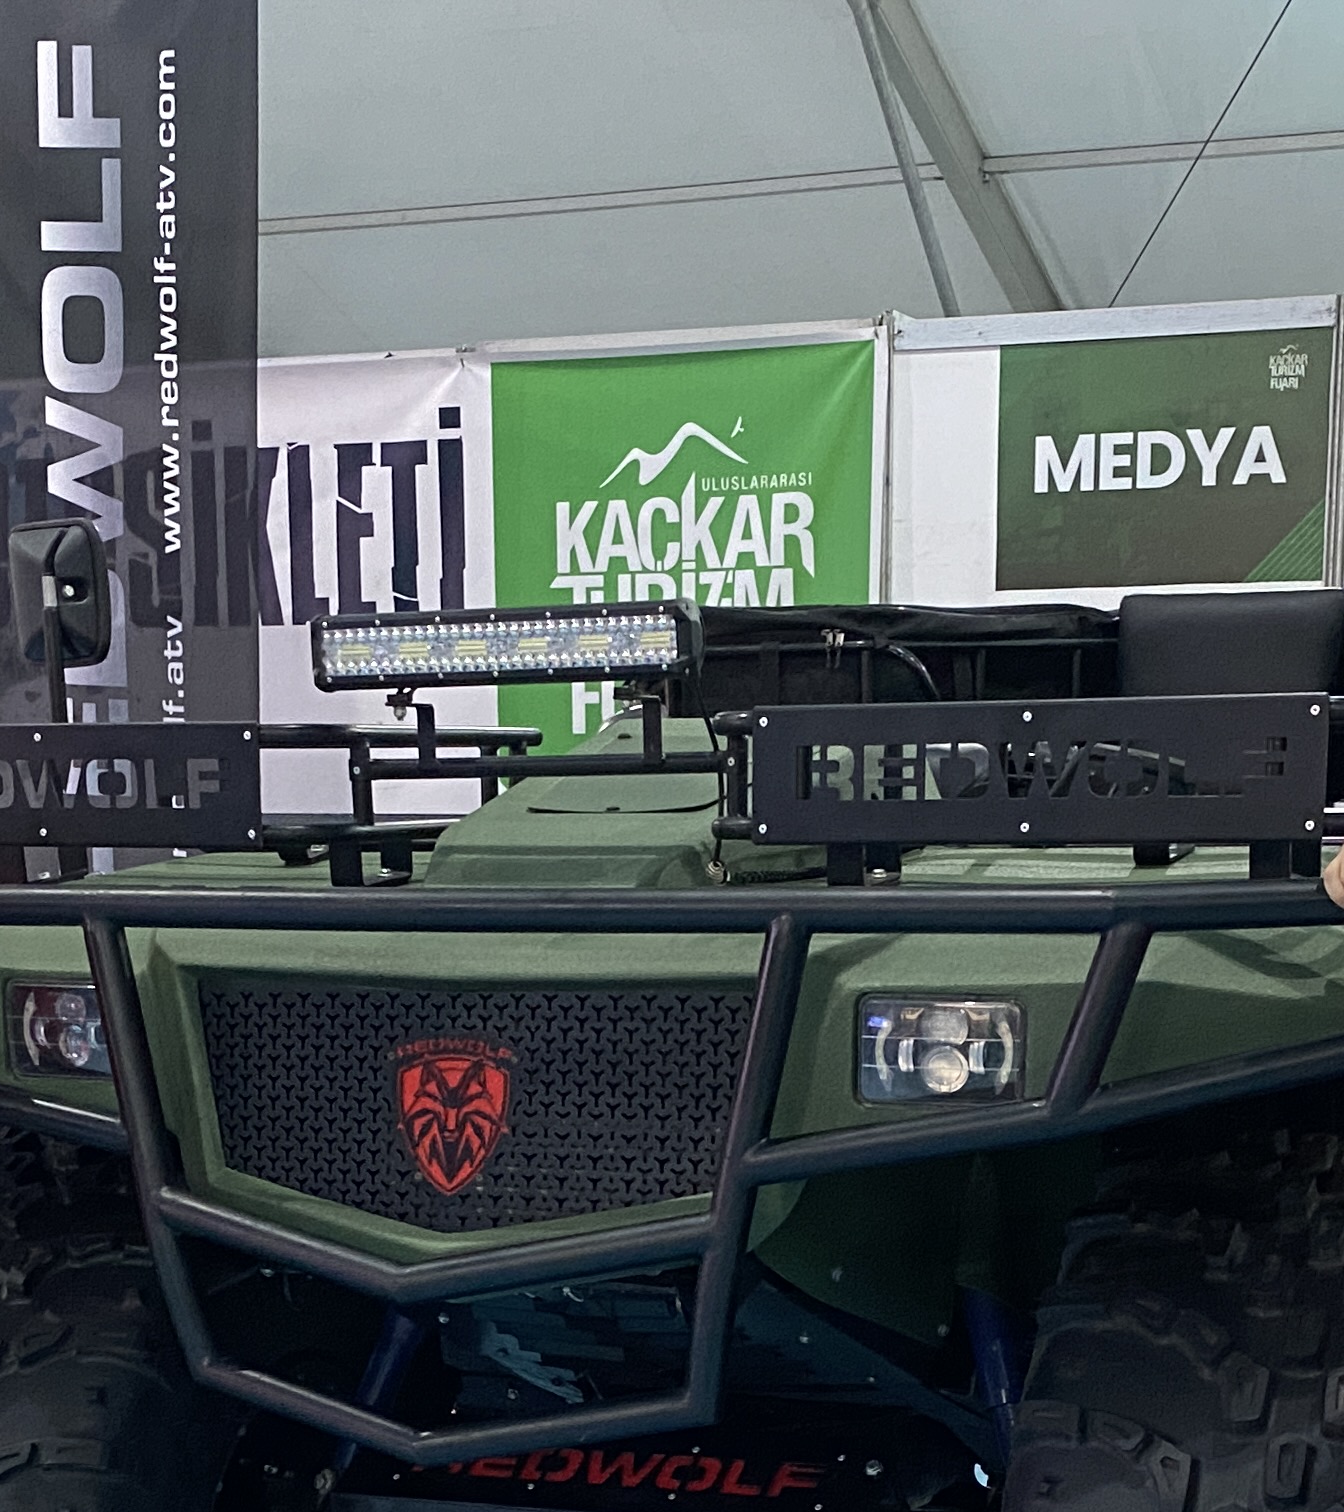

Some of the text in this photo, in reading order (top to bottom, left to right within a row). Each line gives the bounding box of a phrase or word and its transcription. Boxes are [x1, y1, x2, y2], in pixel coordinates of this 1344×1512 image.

[153, 48, 182, 554] www.redwolf-atv.com
[701, 472, 813, 492] ULUSLARARASI
[1033, 426, 1287, 493] MEDYA
[555, 471, 816, 579] KAÇKAR
[413, 1449, 827, 1496] EDWOLF
